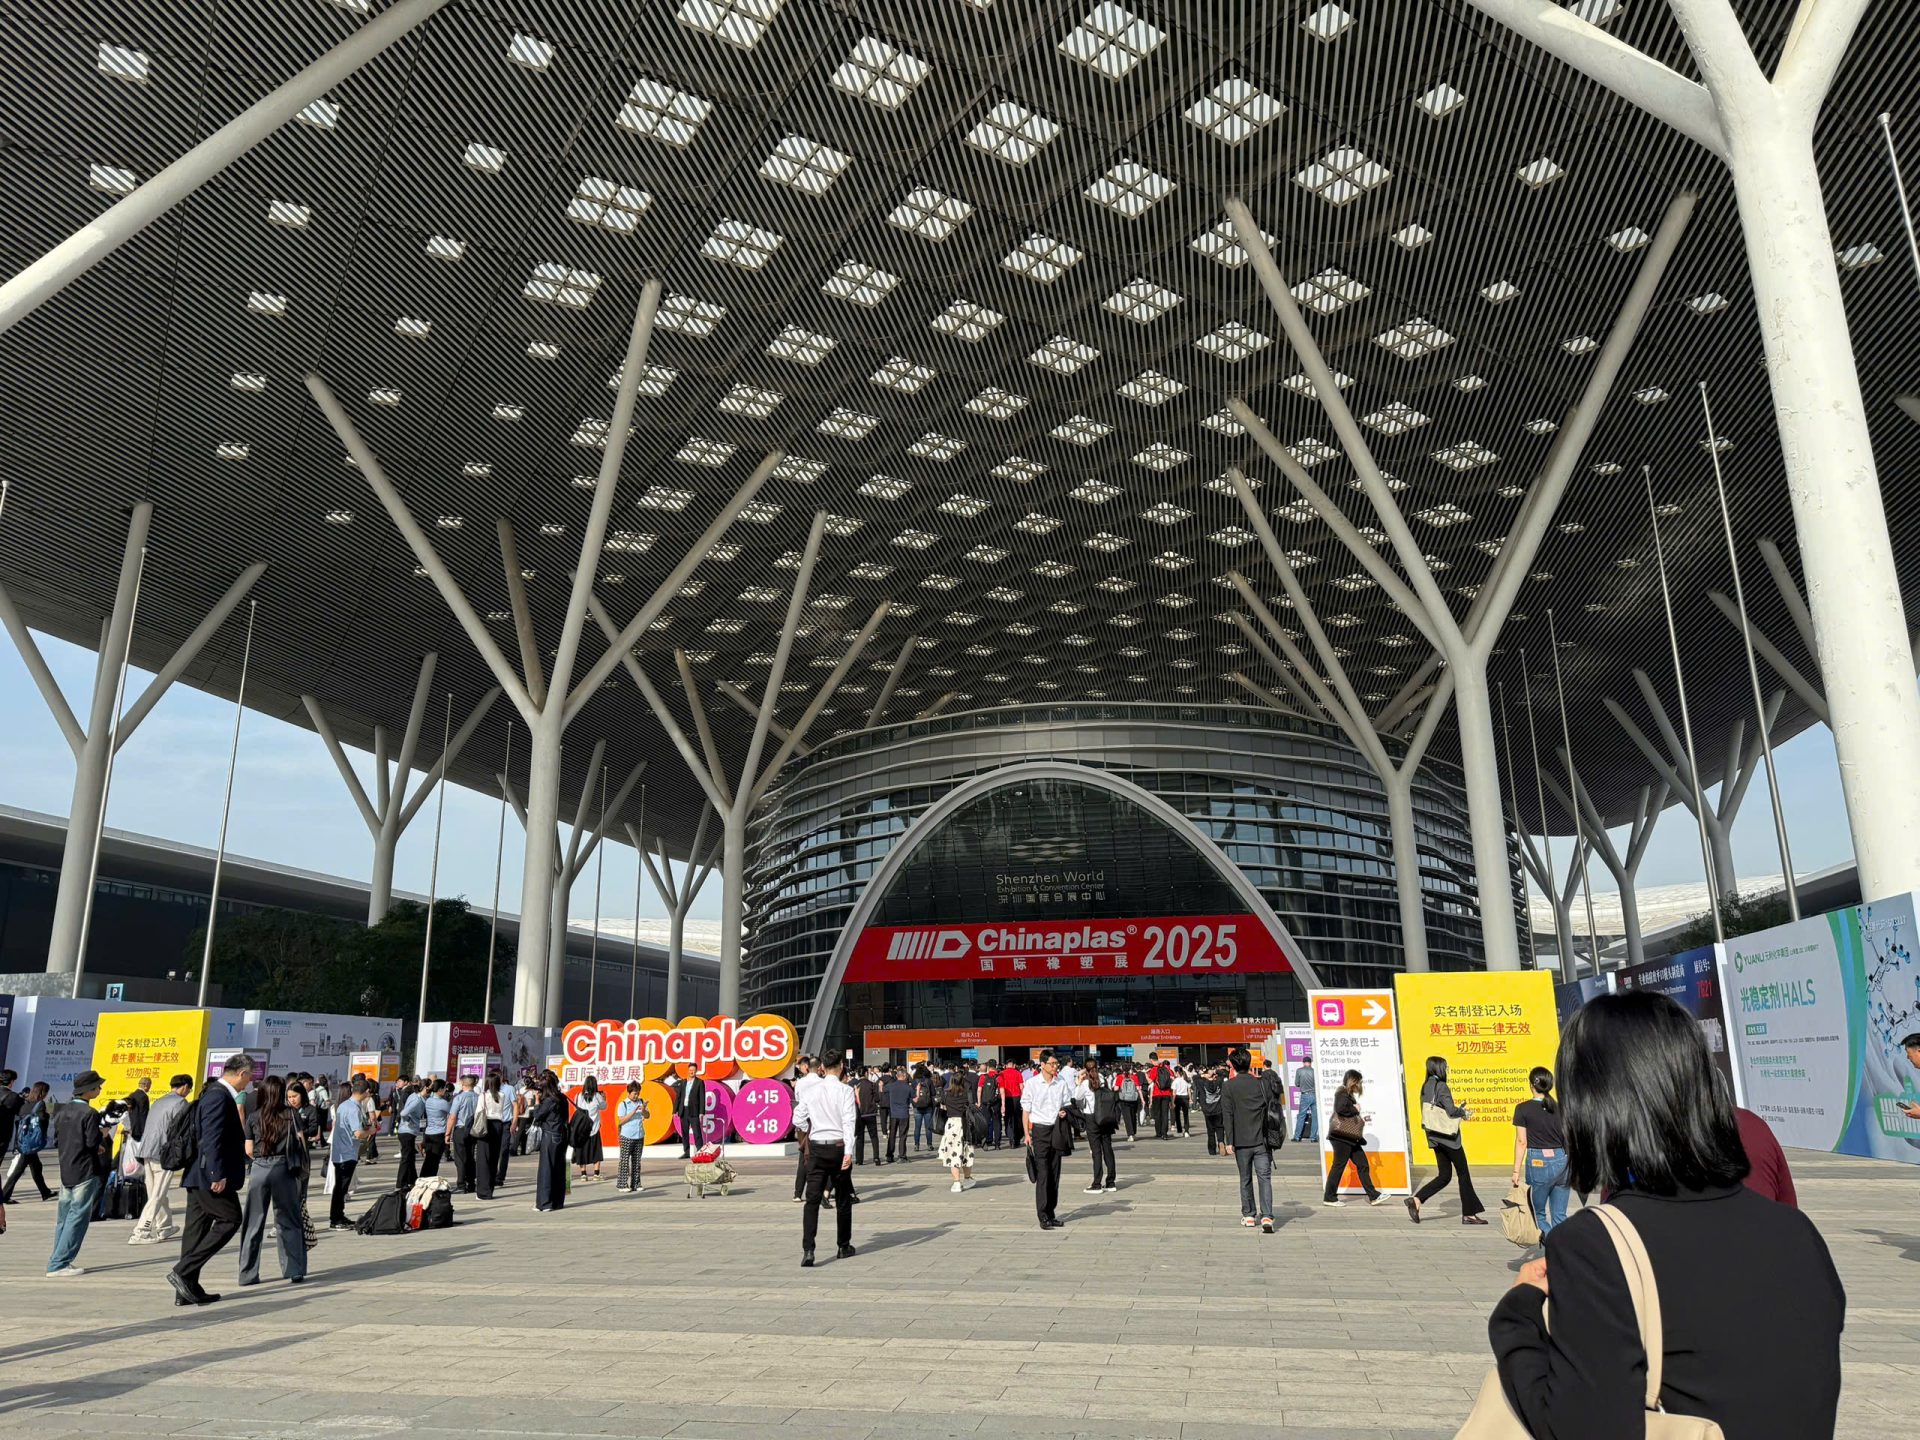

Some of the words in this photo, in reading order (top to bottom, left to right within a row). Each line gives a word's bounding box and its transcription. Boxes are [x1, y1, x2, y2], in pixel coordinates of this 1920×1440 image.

[995, 873, 1059, 885] Shenzhen
[1063, 869, 1104, 882] World
[1081, 882, 1104, 890] Center
[1143, 924, 1237, 968] 2025
[980, 955, 1128, 971] 国际橡塑展
[1433, 1004, 1522, 1018] 实名制登记入场
[48, 1029, 70, 1037] BLOW
[71, 1030, 96, 1038] MOLDIN
[1430, 1022, 1531, 1035] 黄牛票证一律无效
[117, 1037, 177, 1048] 实名制登记入场
[563, 1019, 788, 1073] Chinaplas
[1319, 1038, 1380, 1048] 大会免费巴士
[1456, 1041, 1507, 1053] 切勿购买
[126, 1067, 160, 1078] 切勿购买
[564, 1066, 641, 1082] 国际橡塑展
[1474, 1067, 1528, 1075] Authentication
[1486, 1076, 1528, 1085] registration
[1486, 1085, 1524, 1093] admission
